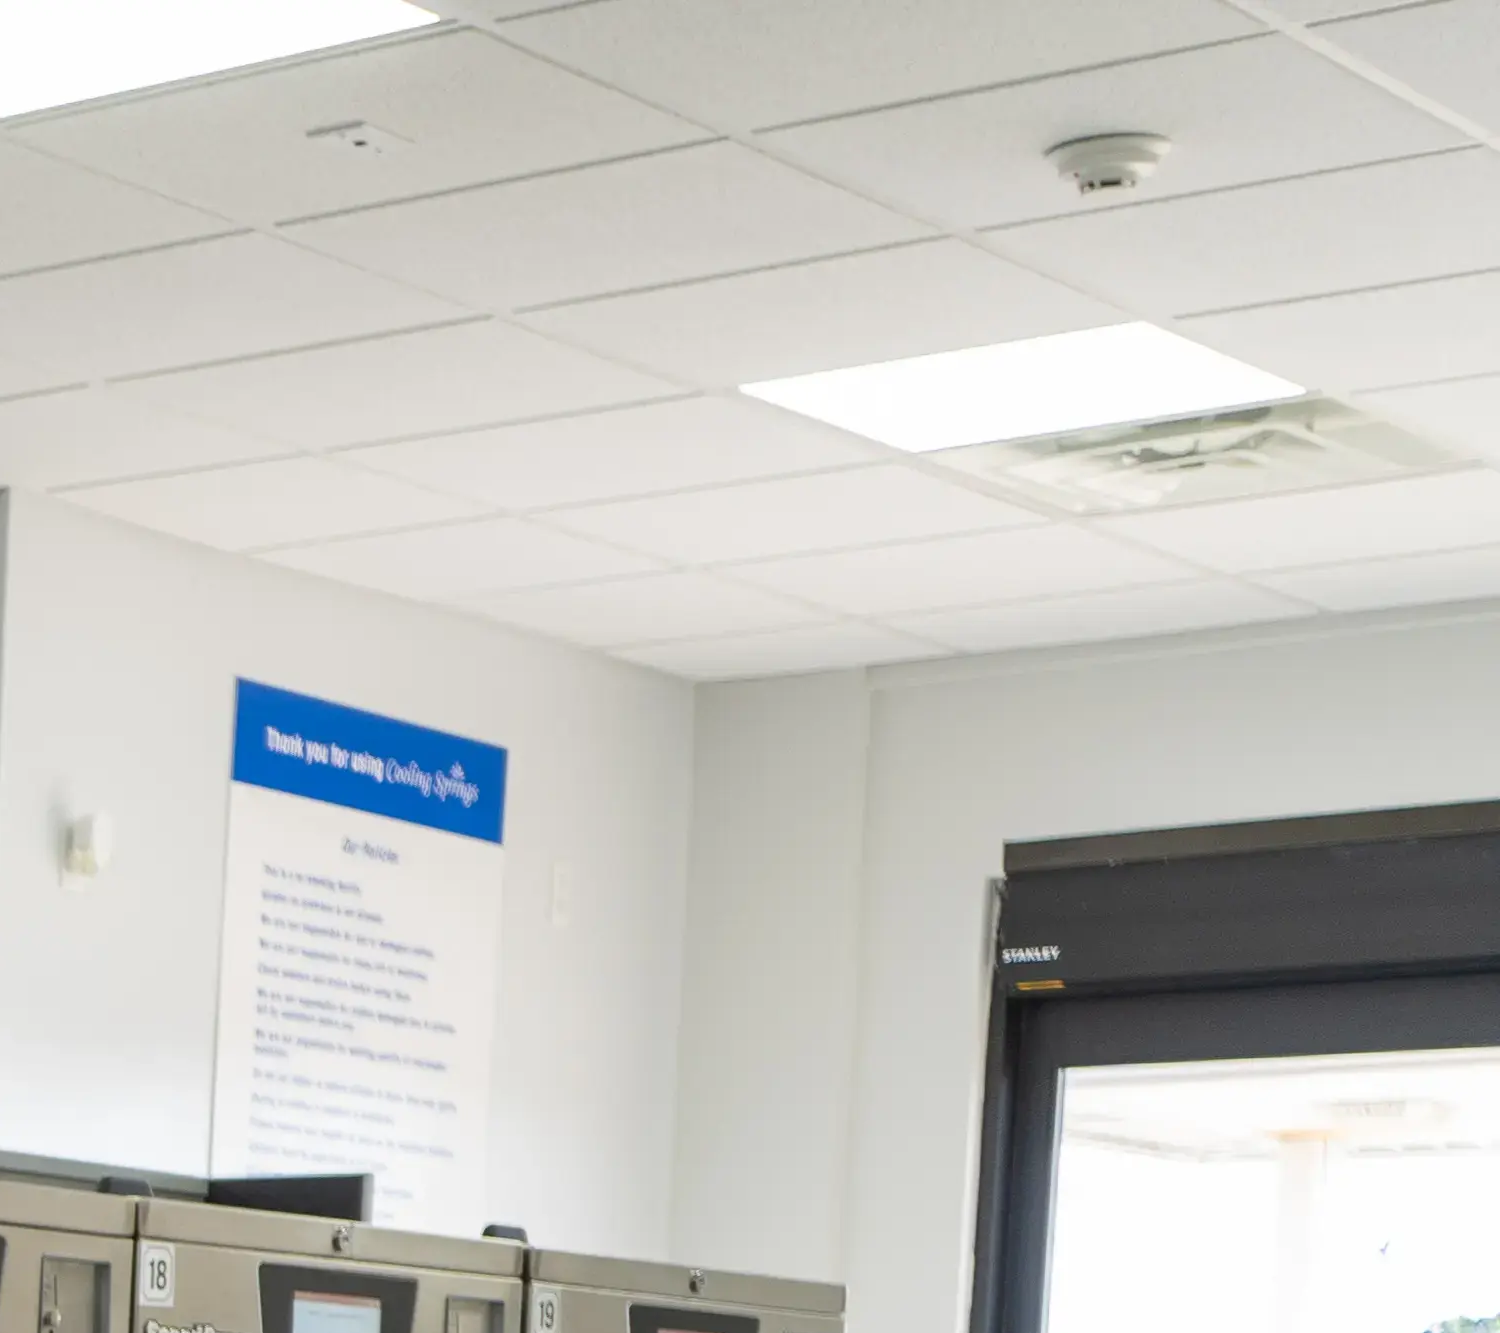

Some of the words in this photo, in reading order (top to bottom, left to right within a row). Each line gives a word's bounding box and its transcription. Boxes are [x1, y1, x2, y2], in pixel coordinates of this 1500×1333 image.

[265, 725, 303, 758] Thank
[305, 739, 328, 765] you
[331, 742, 349, 769] for
[351, 751, 384, 783] using
[386, 758, 431, 798] Cooling
[433, 770, 479, 808] Springs
[1002, 945, 1061, 963] STANLEY
[149, 1258, 168, 1291] 18
[539, 1300, 555, 1330] 19
